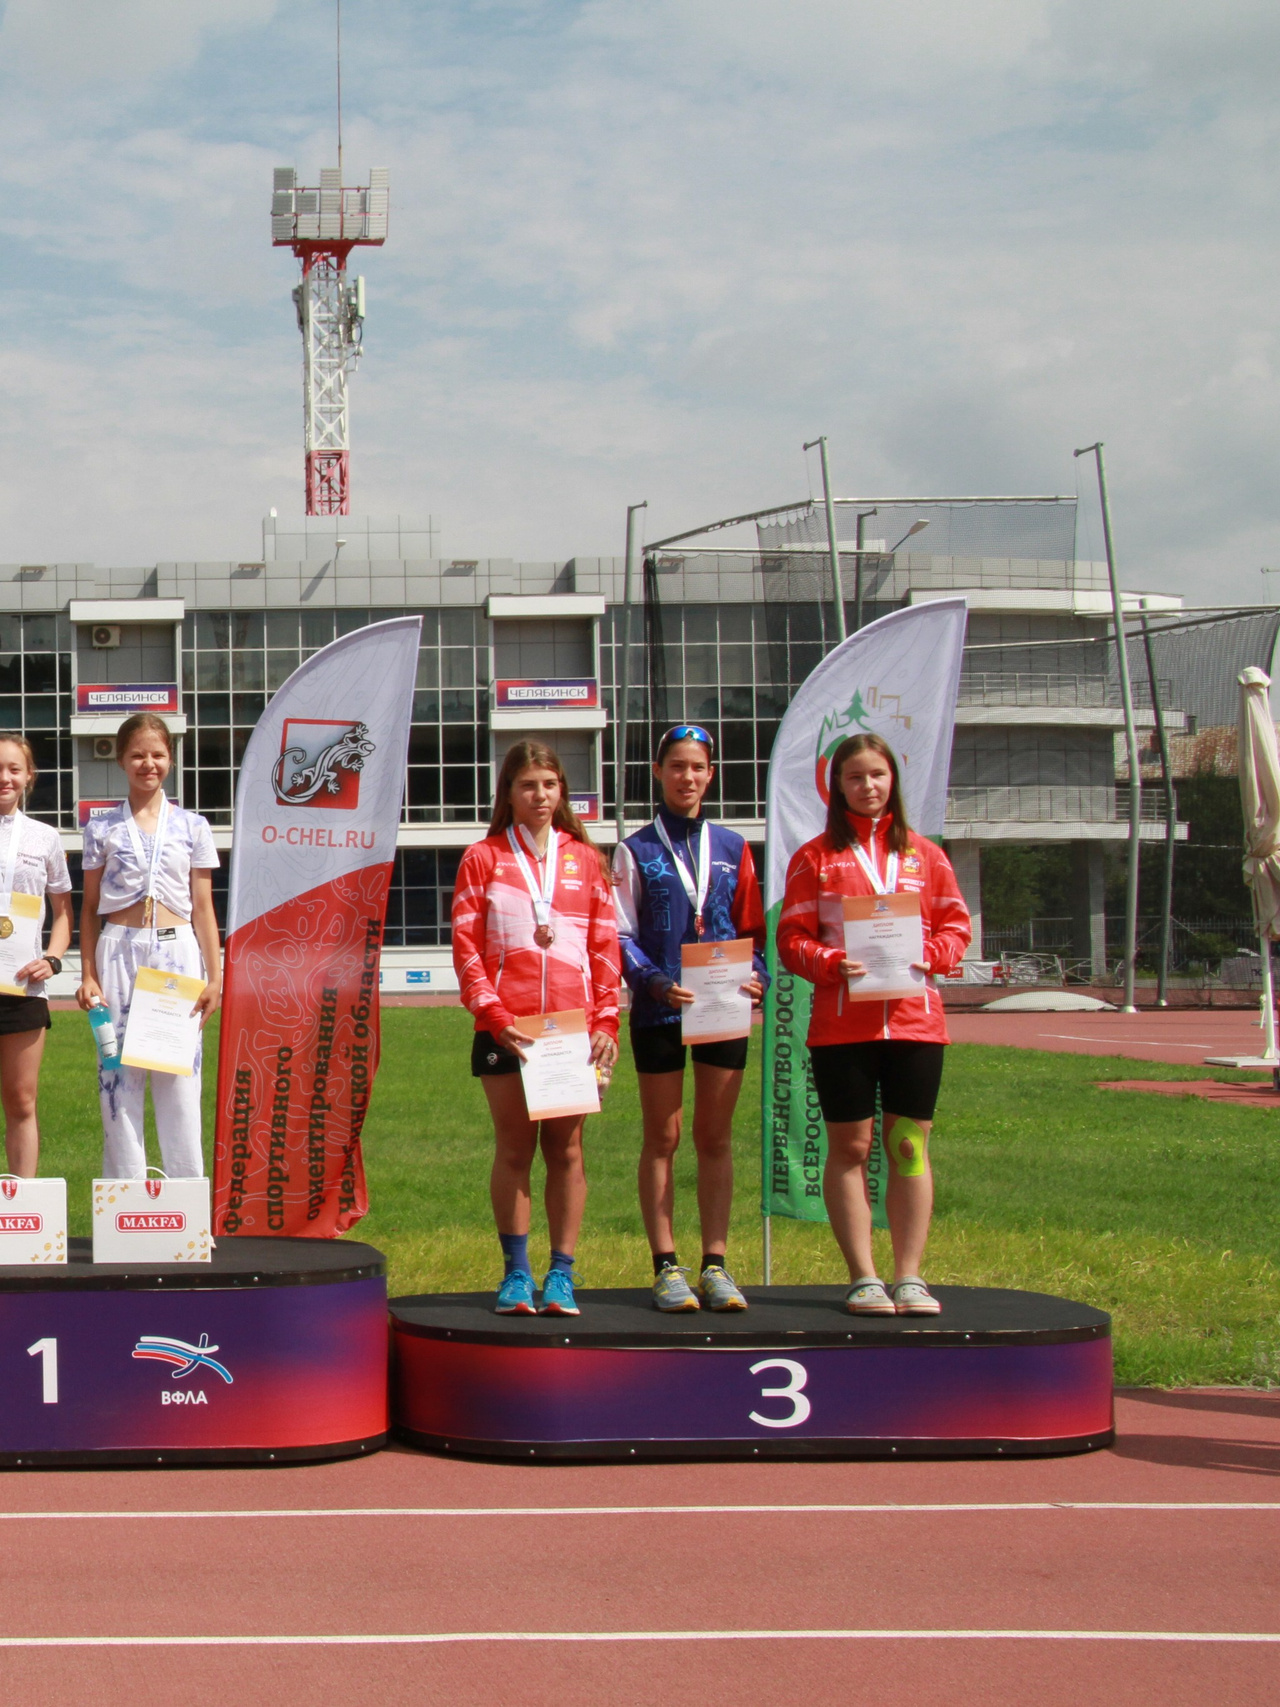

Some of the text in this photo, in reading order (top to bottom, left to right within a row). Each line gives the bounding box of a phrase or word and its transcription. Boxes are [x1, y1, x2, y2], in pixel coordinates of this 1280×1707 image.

[90, 693, 166, 703] ЧЕЛЯБИНСК
[509, 687, 586, 698] ЧЕЛЯБИНСК
[261, 825, 376, 849] O-CHEL.RU
[350, 919, 382, 1040] области
[306, 986, 338, 1222] ориентирования
[772, 956, 795, 1197] ПЕРВЕНСТВО РОССИ
[223, 1069, 252, 1234] Федерация
[266, 1046, 294, 1232] спортивного
[123, 1217, 179, 1228] MAKFA
[26, 1337, 59, 1404] 1
[161, 1389, 209, 1405] ВФЛА
[748, 1358, 811, 1428] 3
